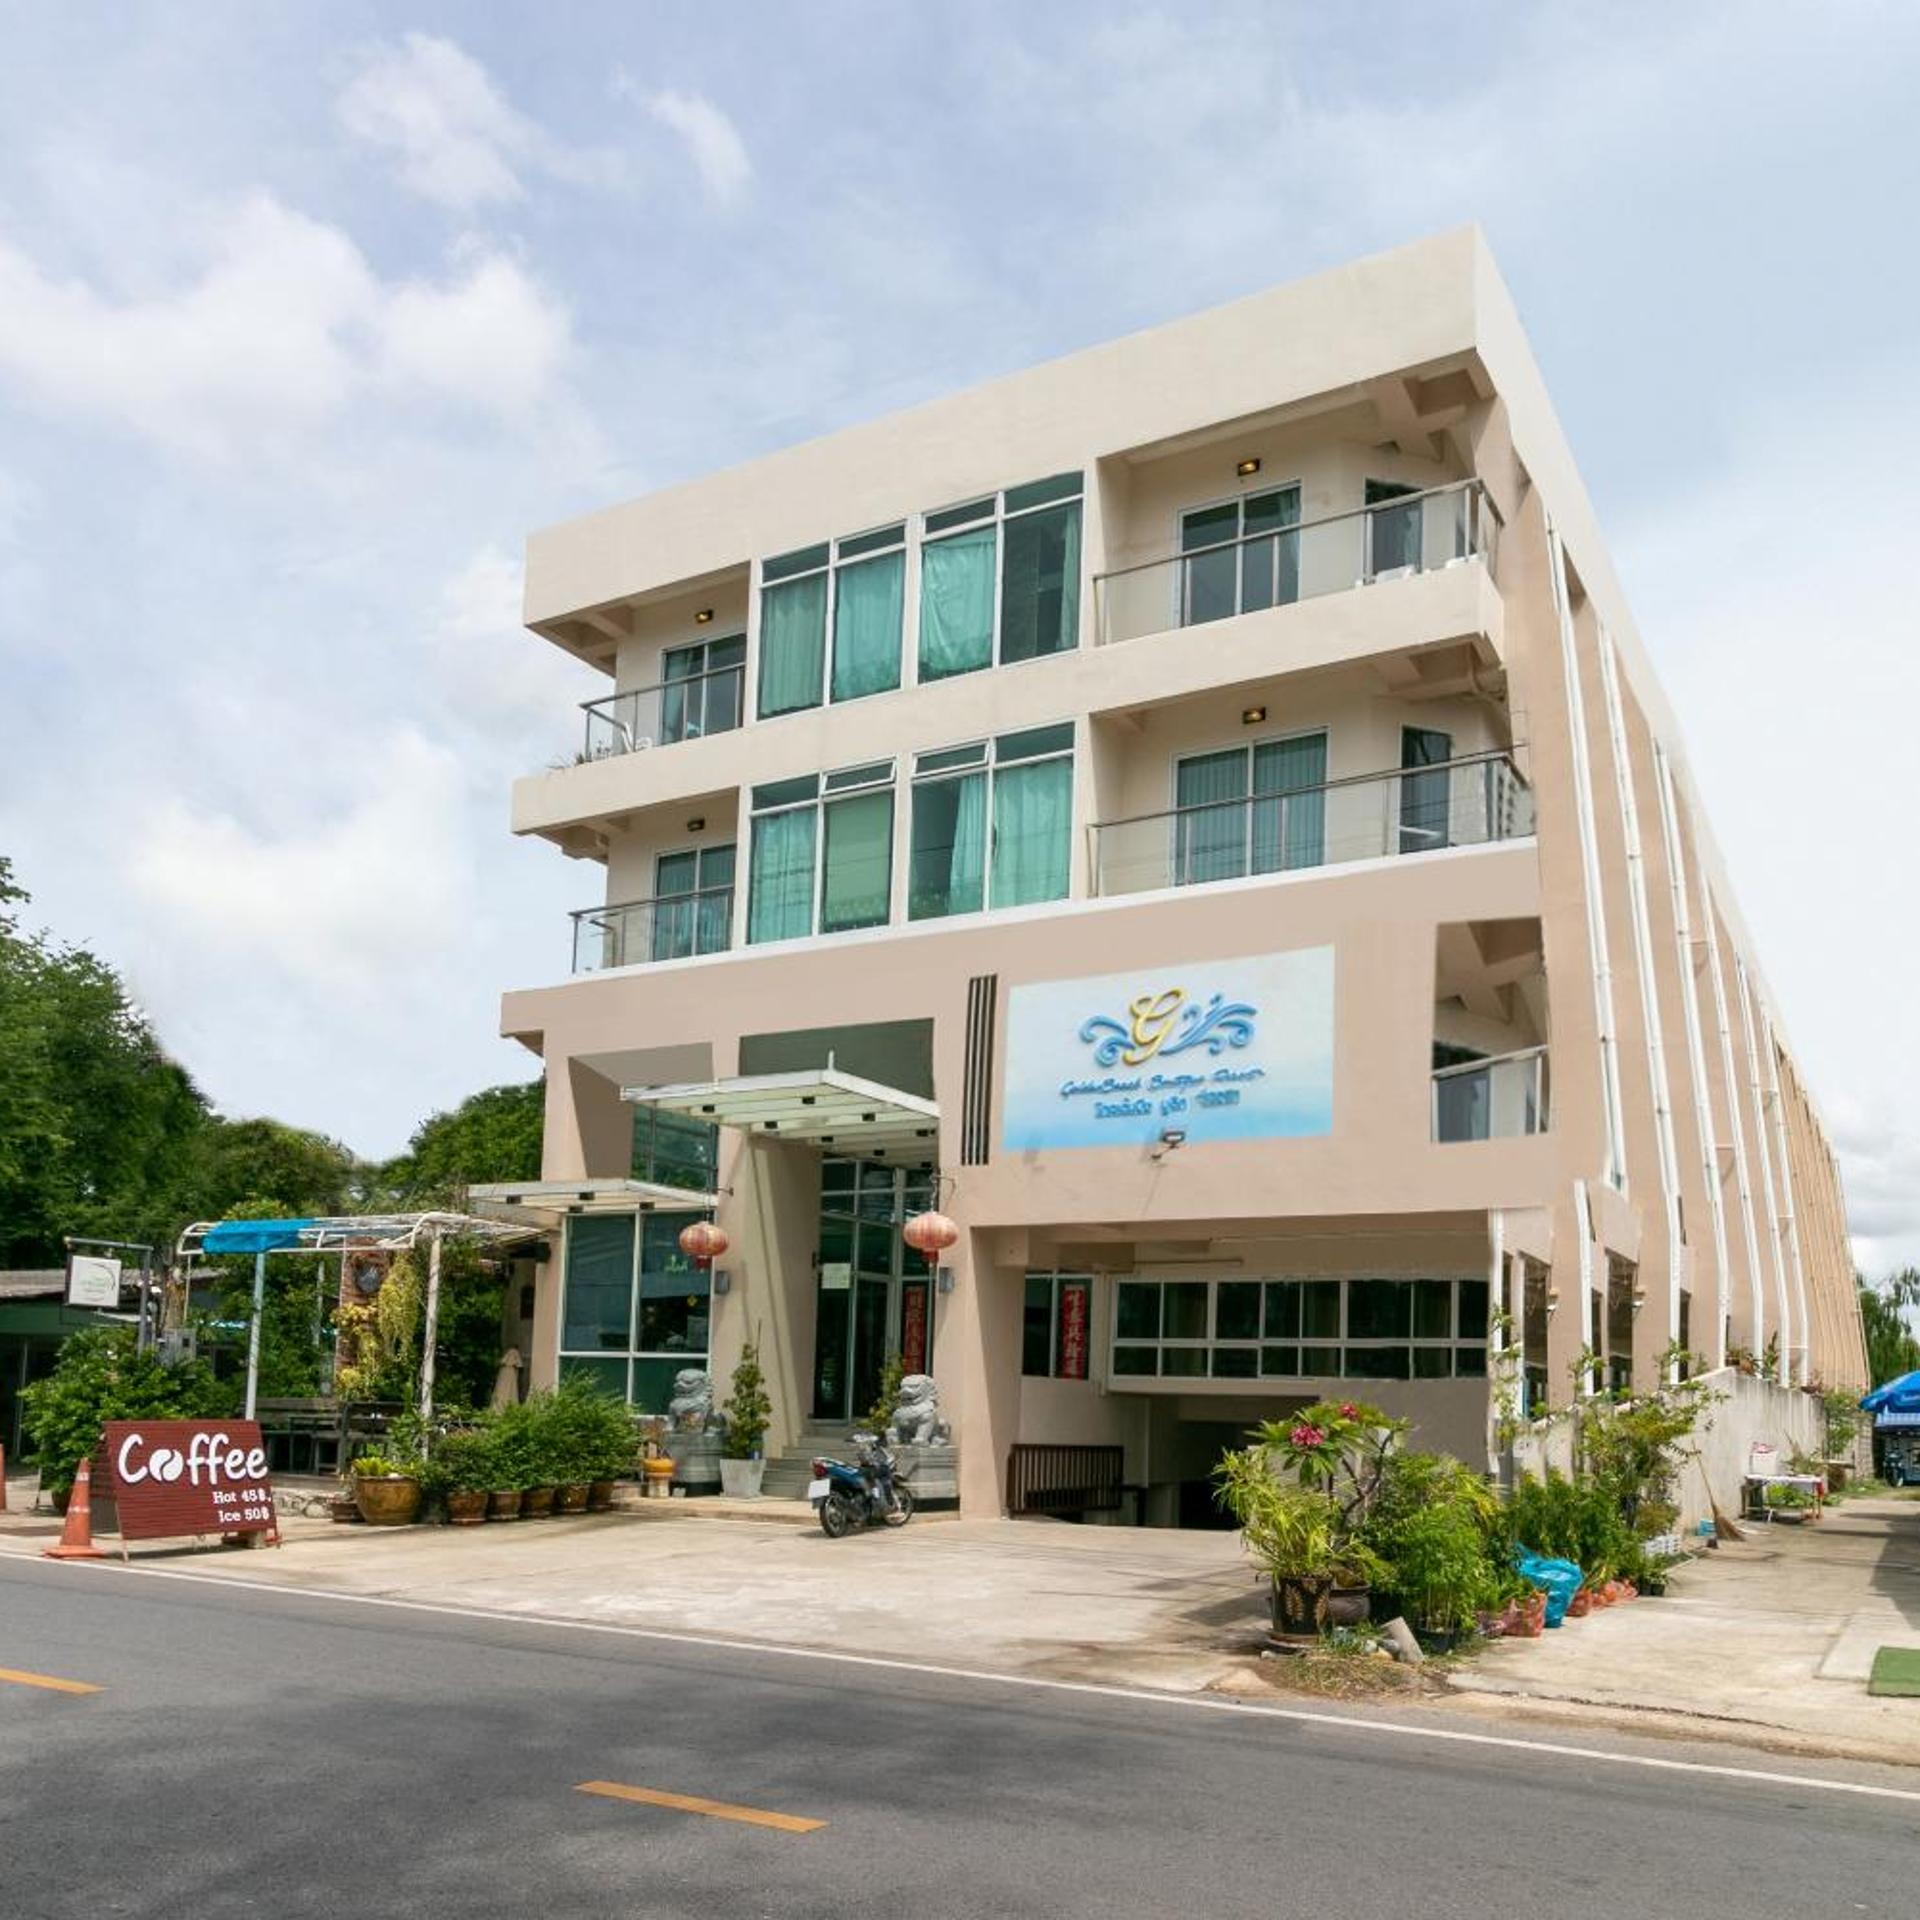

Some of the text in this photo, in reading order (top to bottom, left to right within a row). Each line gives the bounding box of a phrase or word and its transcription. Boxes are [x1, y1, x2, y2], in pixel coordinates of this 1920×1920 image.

[118, 1433, 269, 1486] Coffee
[213, 1490, 237, 1504] Hot
[218, 1510, 241, 1522] Ice
